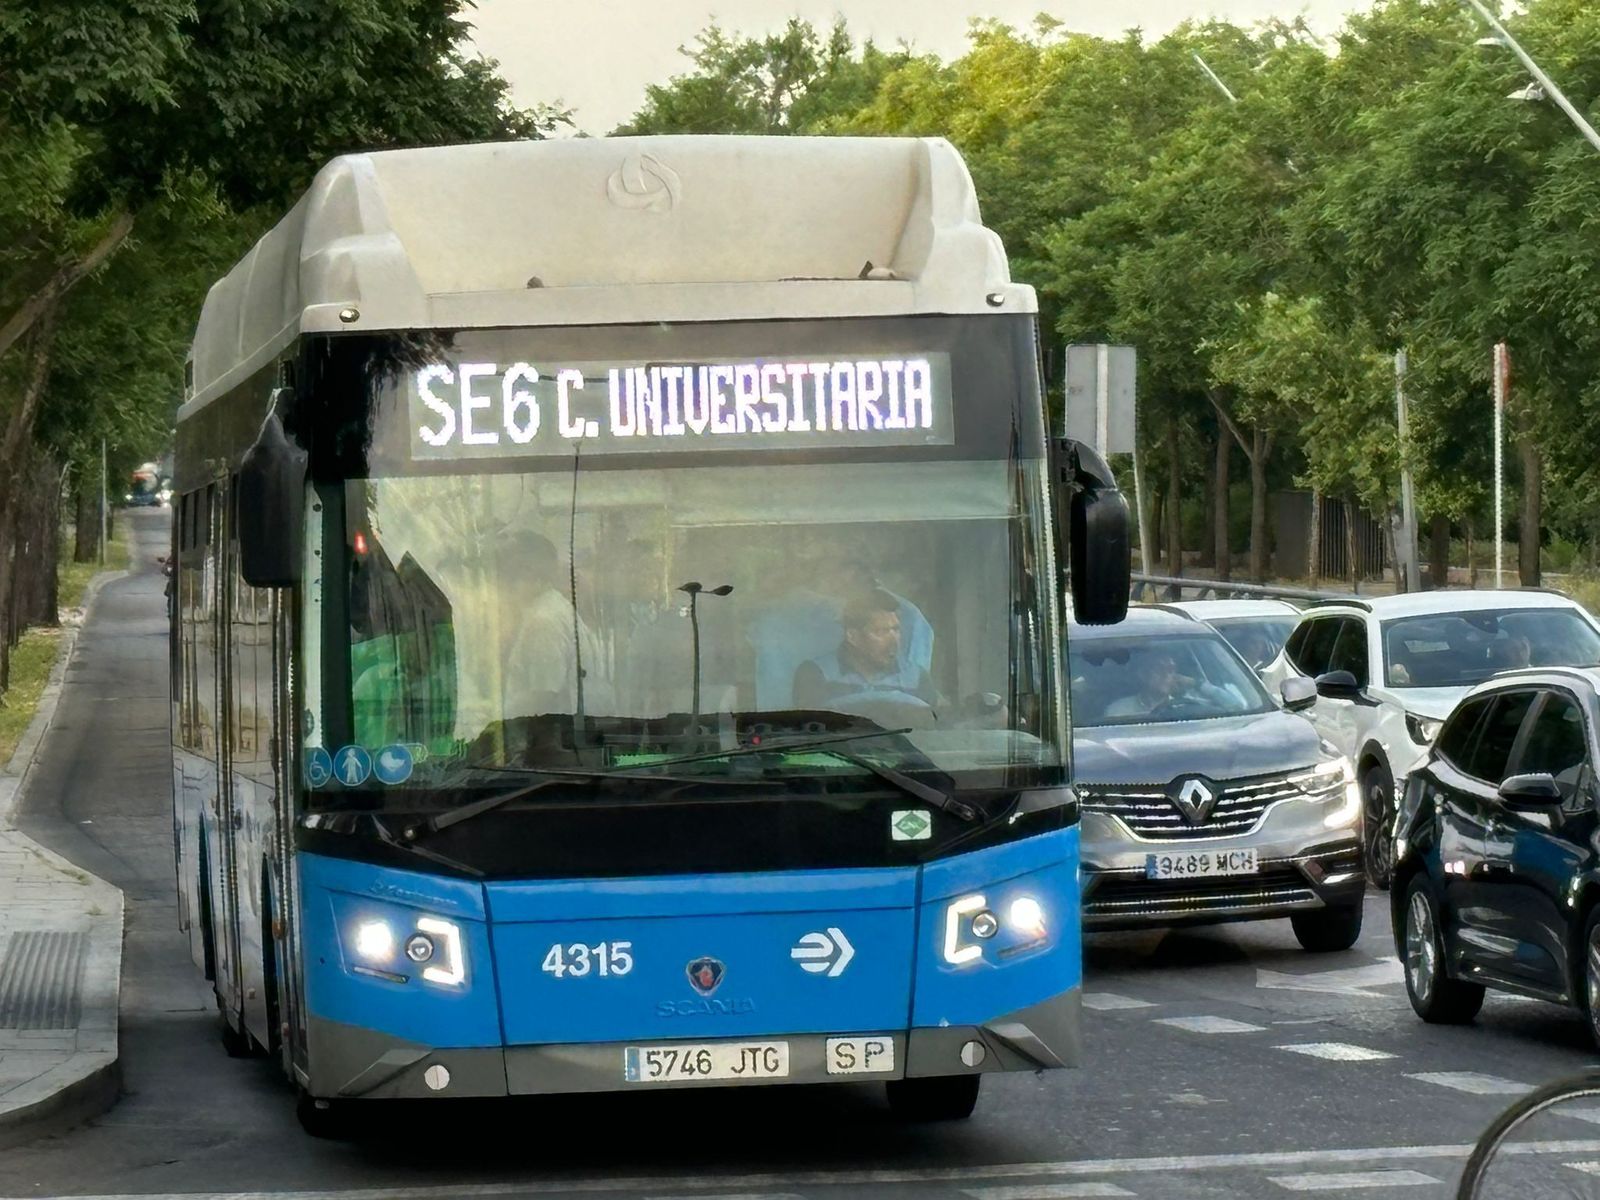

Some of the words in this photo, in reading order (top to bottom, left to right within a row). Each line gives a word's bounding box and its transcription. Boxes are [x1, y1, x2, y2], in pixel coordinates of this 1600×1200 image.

[417, 362, 541, 446] SE6
[557, 369, 599, 438] C.
[609, 359, 933, 437] UNIVERSITARIA
[542, 941, 633, 978] 4315
[646, 1049, 712, 1077] 5746
[731, 1046, 780, 1075] JTG
